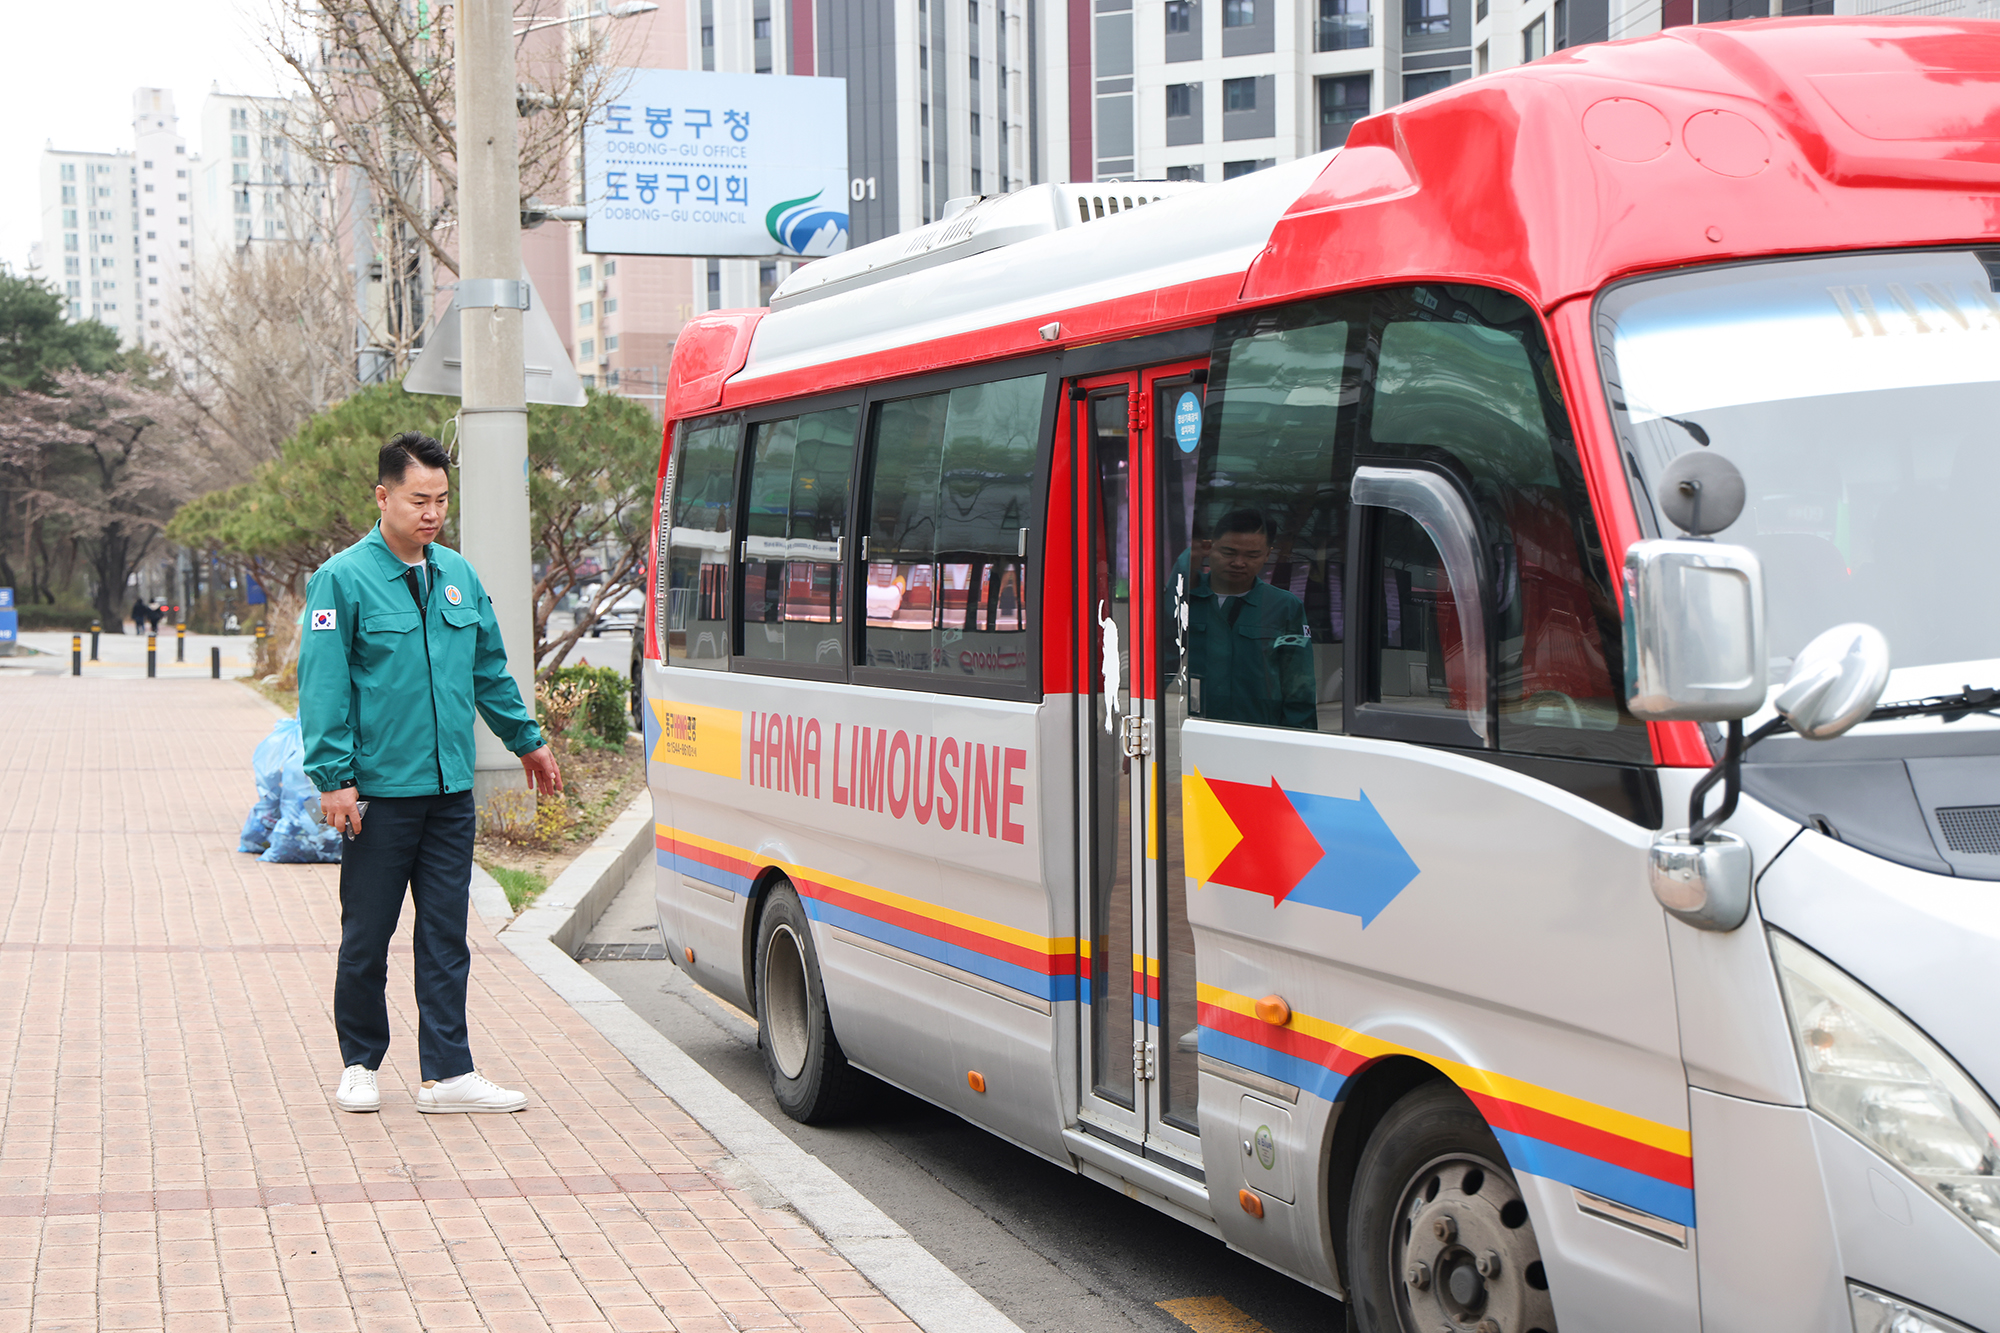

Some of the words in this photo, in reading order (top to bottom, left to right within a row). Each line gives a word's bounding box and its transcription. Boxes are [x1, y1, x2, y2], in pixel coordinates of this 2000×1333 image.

[605, 105, 750, 142] 도봉구청
[607, 141, 699, 157] DOBONG-GU
[703, 145, 747, 159] OFFICE
[605, 171, 748, 207] 도봉구의회
[605, 207, 689, 222] DOBONG-GU
[692, 210, 747, 224] COUNCIL
[749, 711, 821, 800] HANA
[832, 722, 1027, 845] LIMOUSINE
